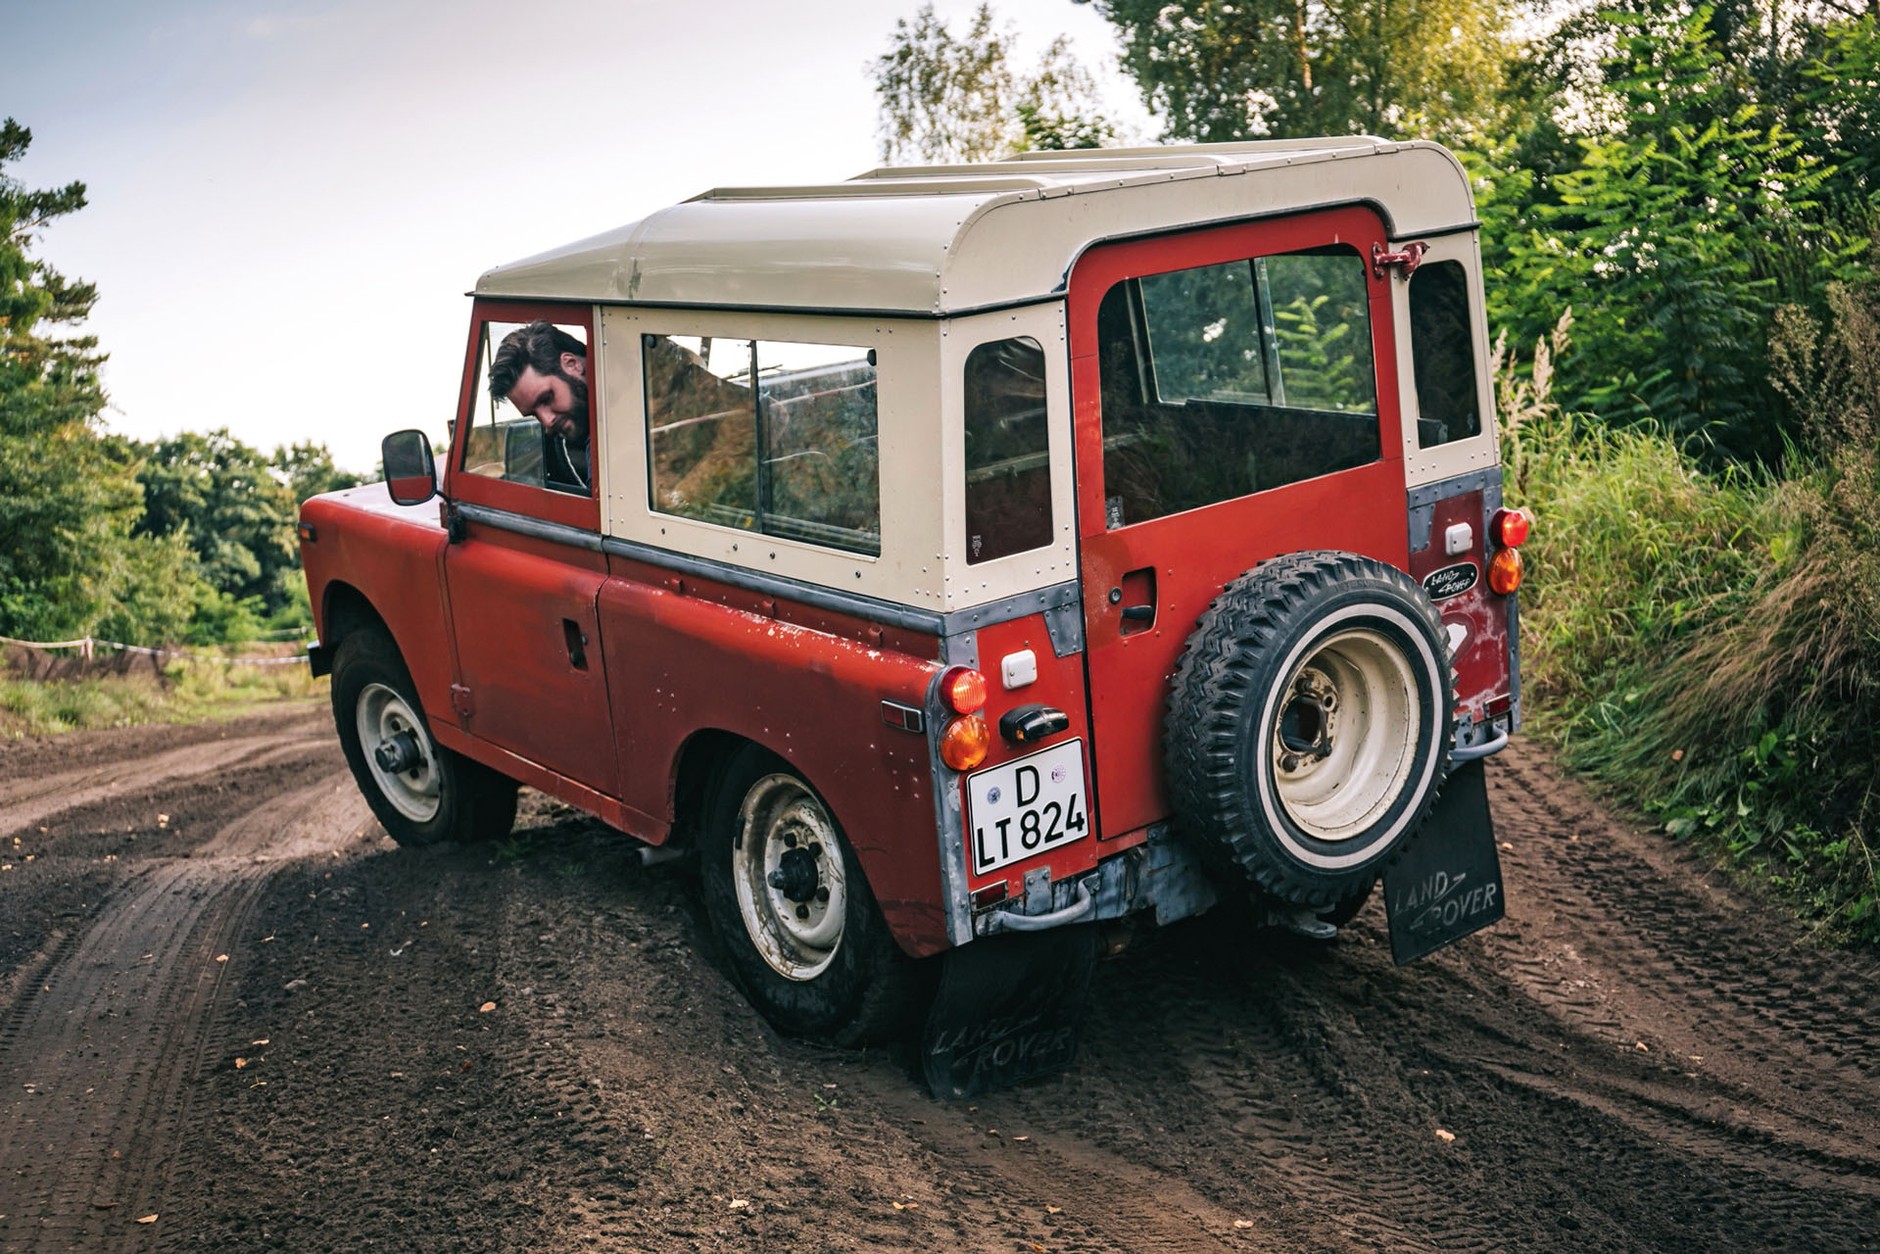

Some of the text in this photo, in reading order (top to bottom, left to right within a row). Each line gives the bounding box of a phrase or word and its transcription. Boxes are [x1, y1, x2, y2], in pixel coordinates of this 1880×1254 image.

[1015, 764, 1040, 808] D
[976, 793, 1085, 868] LT 824
[1393, 871, 1448, 915] LAND
